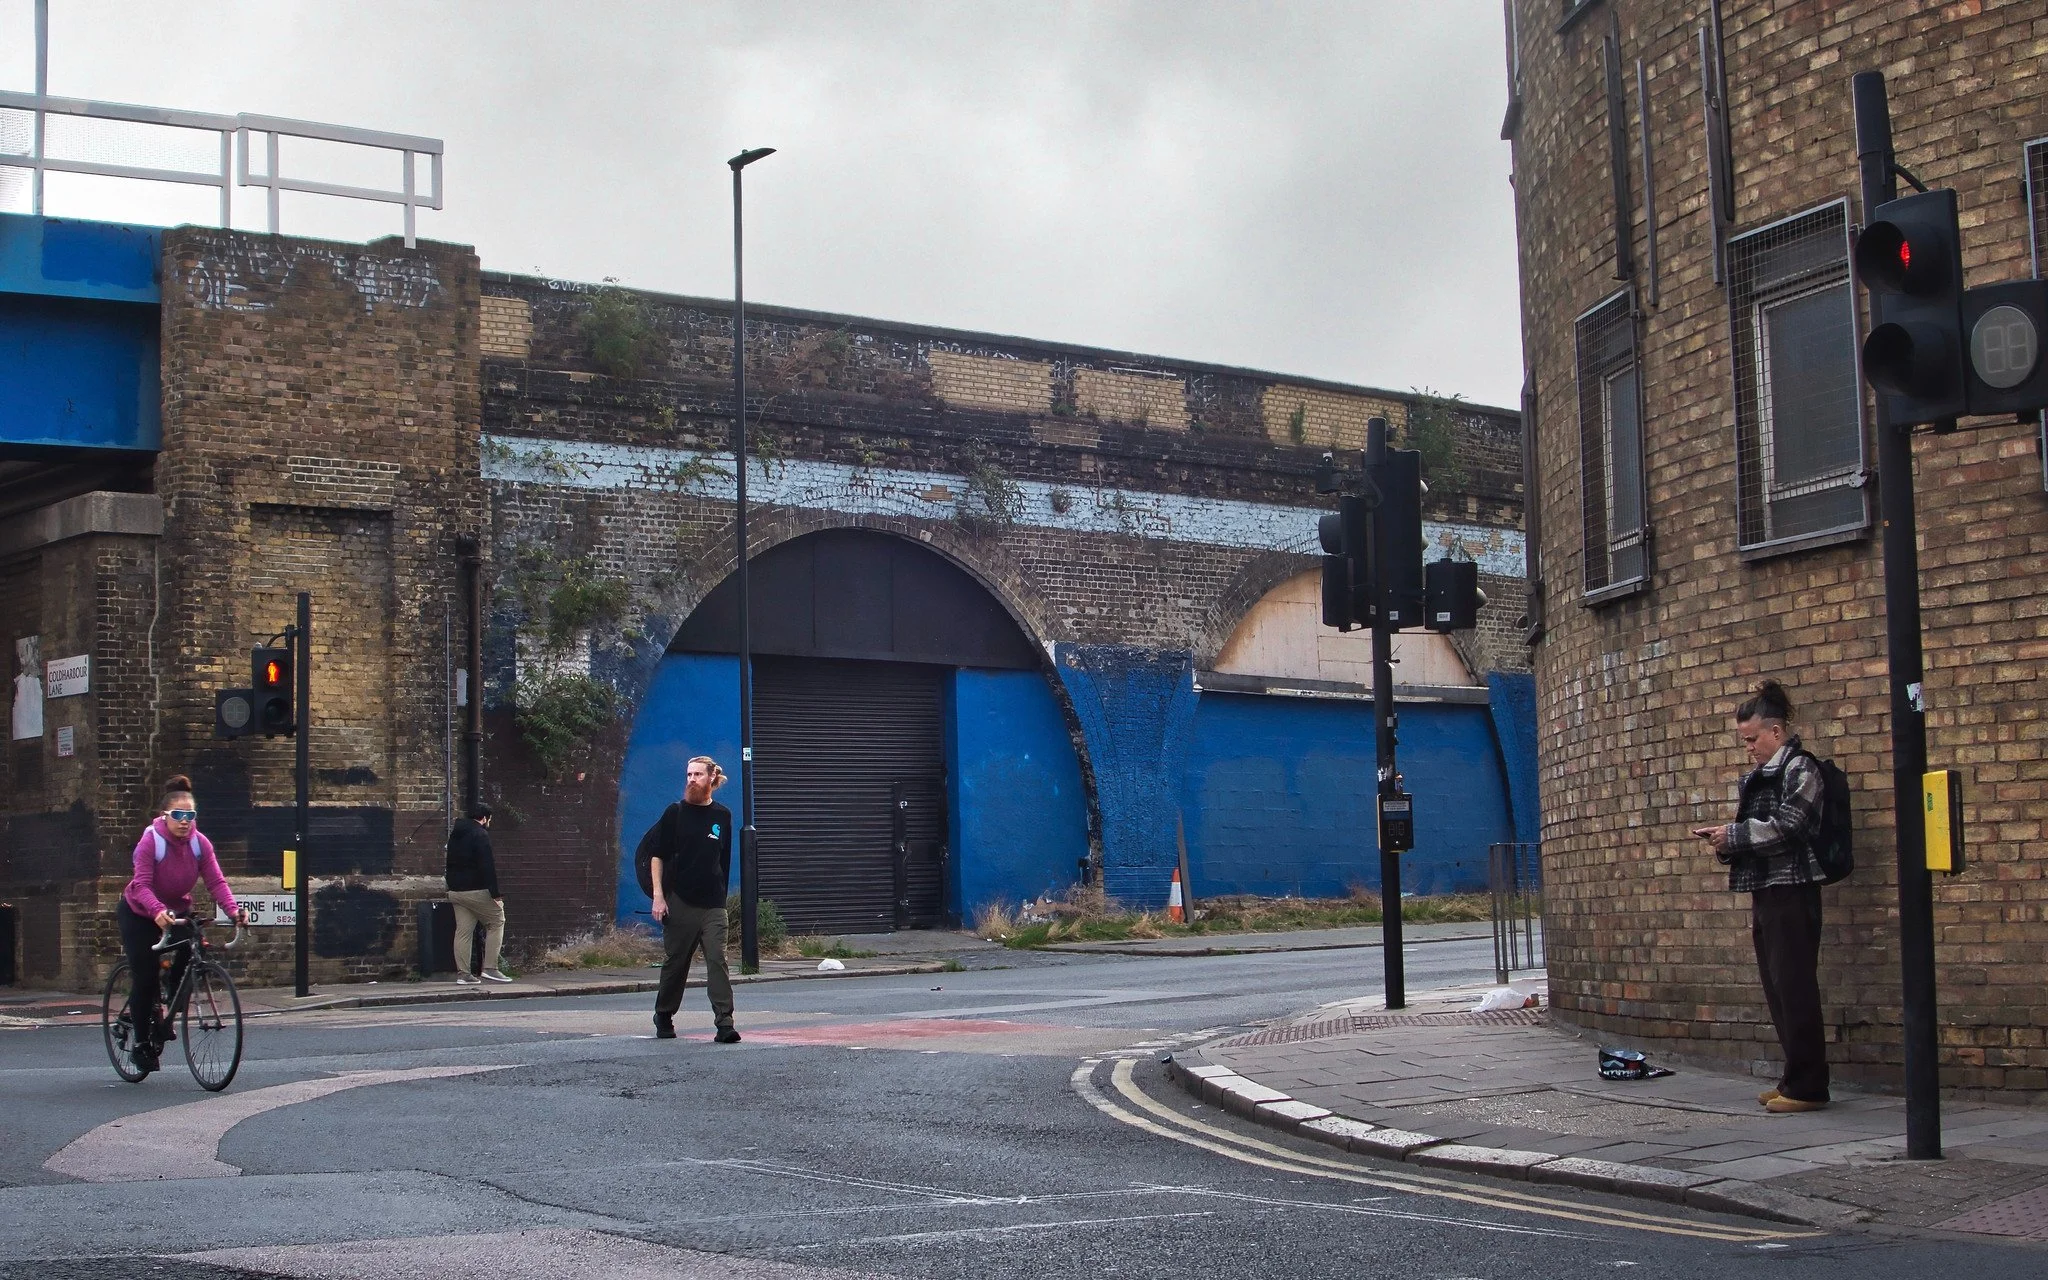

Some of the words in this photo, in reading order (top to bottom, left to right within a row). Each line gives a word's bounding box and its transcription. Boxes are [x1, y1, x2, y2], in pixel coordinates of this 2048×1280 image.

[49, 666, 87, 682] COLDHARBOUR
[49, 684, 62, 696] LANE
[236, 901, 265, 912] ERNE
[273, 901, 296, 912] HILL
